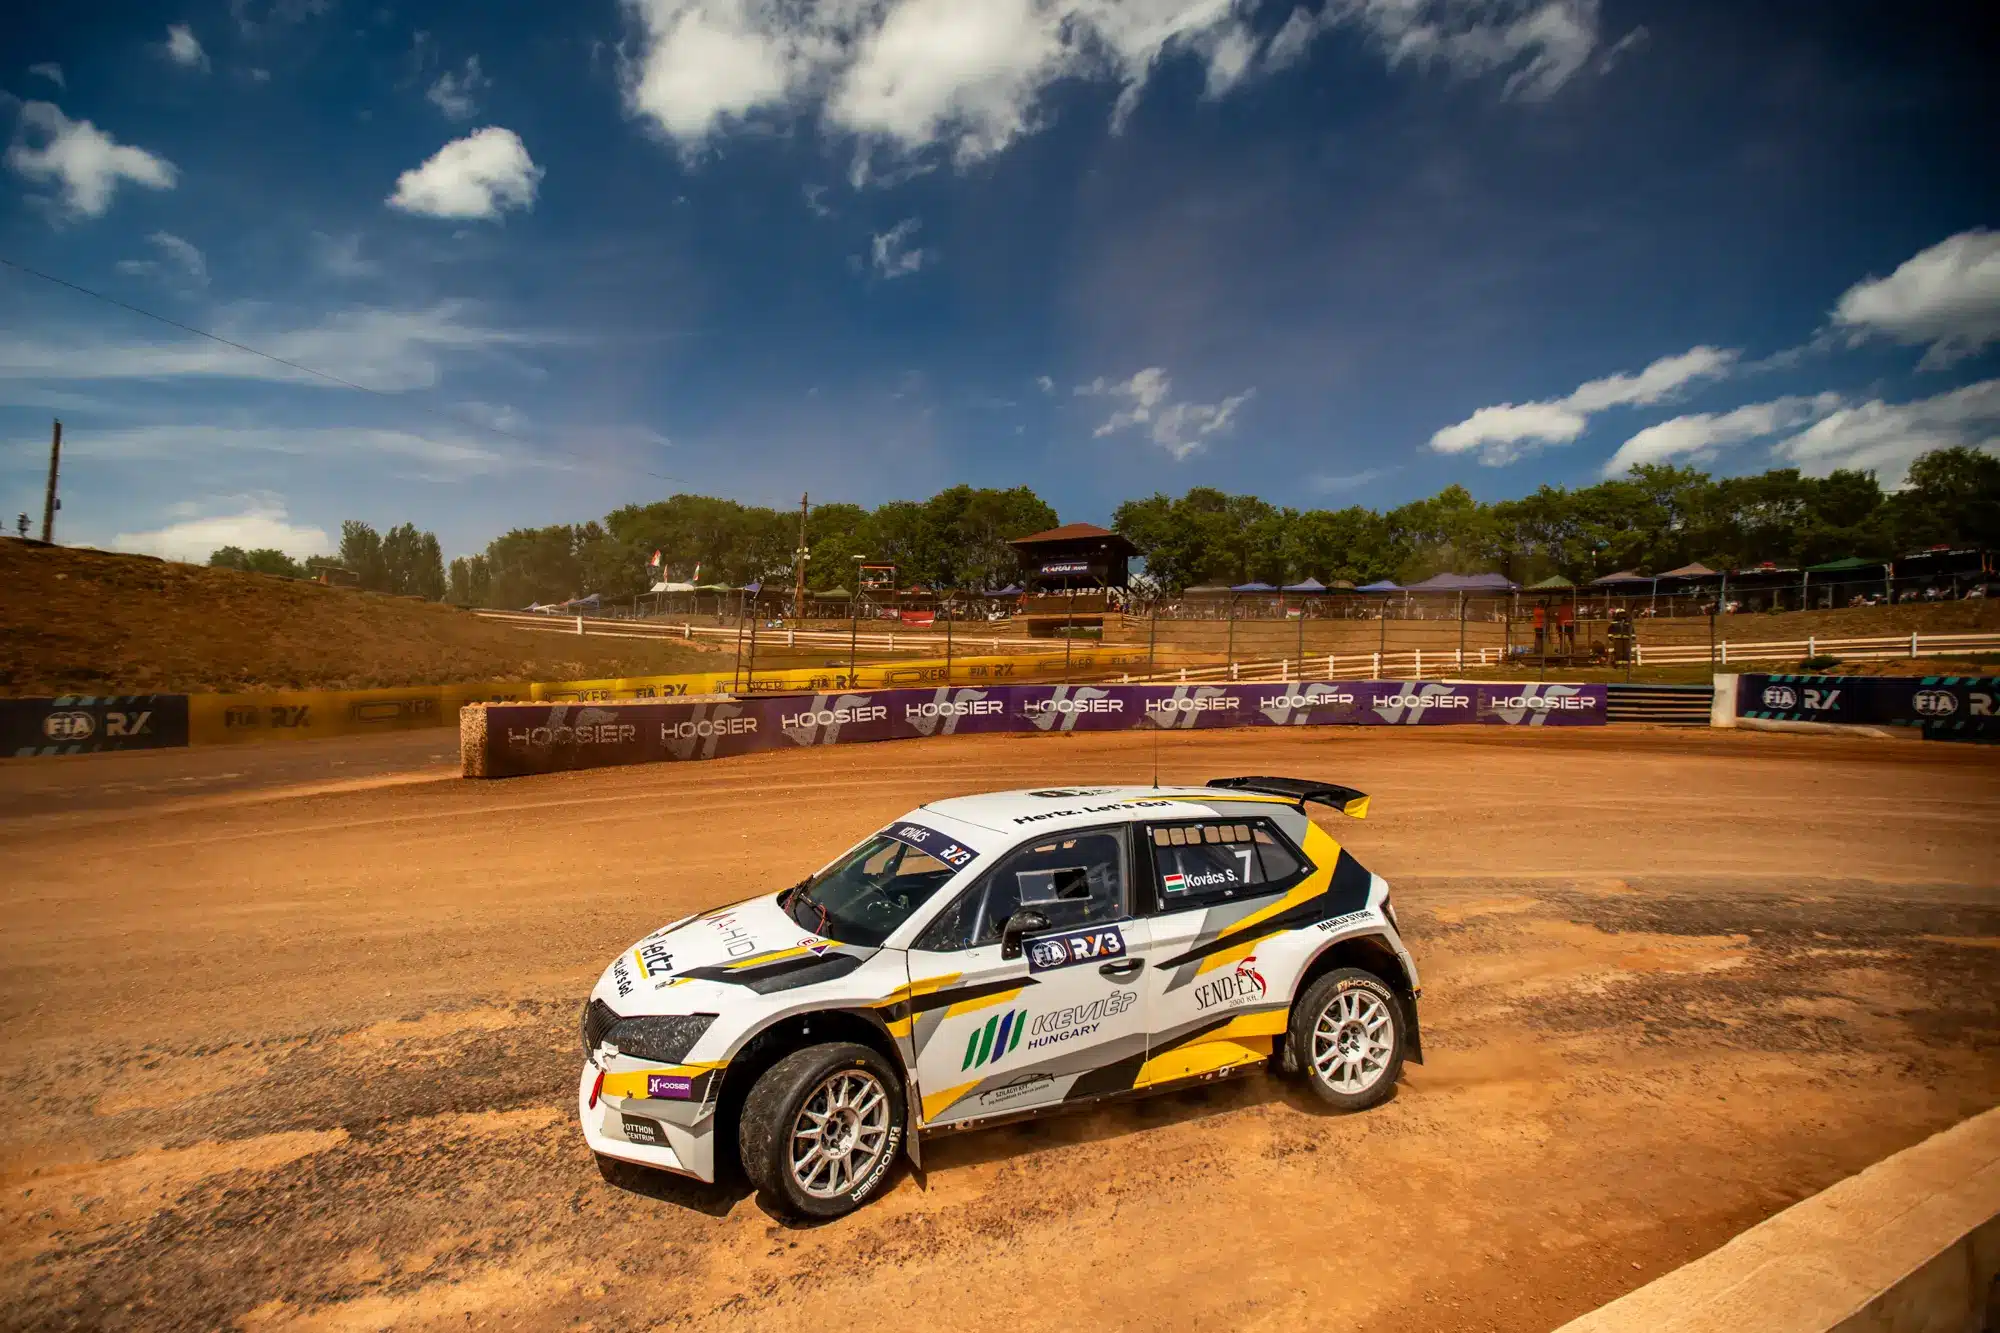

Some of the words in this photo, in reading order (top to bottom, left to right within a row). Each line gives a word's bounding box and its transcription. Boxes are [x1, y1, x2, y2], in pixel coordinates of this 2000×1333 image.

[885, 669, 949, 685] JOKER
[995, 663, 1014, 677] RX
[664, 683, 688, 697] RX
[836, 674, 859, 689] RX
[906, 699, 1004, 718] HOOSIER
[1024, 698, 1124, 714] HOOSIER
[1145, 696, 1240, 713] HOOSIER
[1260, 693, 1354, 709] HOOSIER
[1373, 695, 1469, 709] HOOSIER
[1492, 696, 1596, 711] HOOSIER
[1764, 689, 1796, 706] FIA
[1804, 689, 1841, 710] RX
[1914, 693, 1956, 713] FIA
[45, 714, 93, 737] FIA
[106, 711, 153, 737] RX
[781, 704, 887, 730] HOOSIER
[508, 723, 637, 747] HOOSIER
[661, 717, 758, 741] HOOSIER
[1083, 803, 1135, 813] Let's
[940, 843, 971, 865] RX3
[1234, 849, 1252, 884] 7
[1185, 872, 1226, 888] Kovács
[1226, 869, 1239, 882] S.
[1316, 915, 1349, 932] MARLU
[1347, 910, 1375, 922] STORE
[1033, 943, 1064, 964] FIA
[1069, 932, 1121, 960] RX3
[1348, 979, 1391, 1000] HOOSIER
[1031, 989, 1137, 1036] KEVIÉP
[1228, 998, 1245, 1008] 2000
[1028, 1022, 1100, 1050] HUNGARY
[625, 1123, 654, 1135] OTTHON
[626, 1132, 656, 1142] CENTRUM
[851, 1142, 897, 1202] HOOSIER
